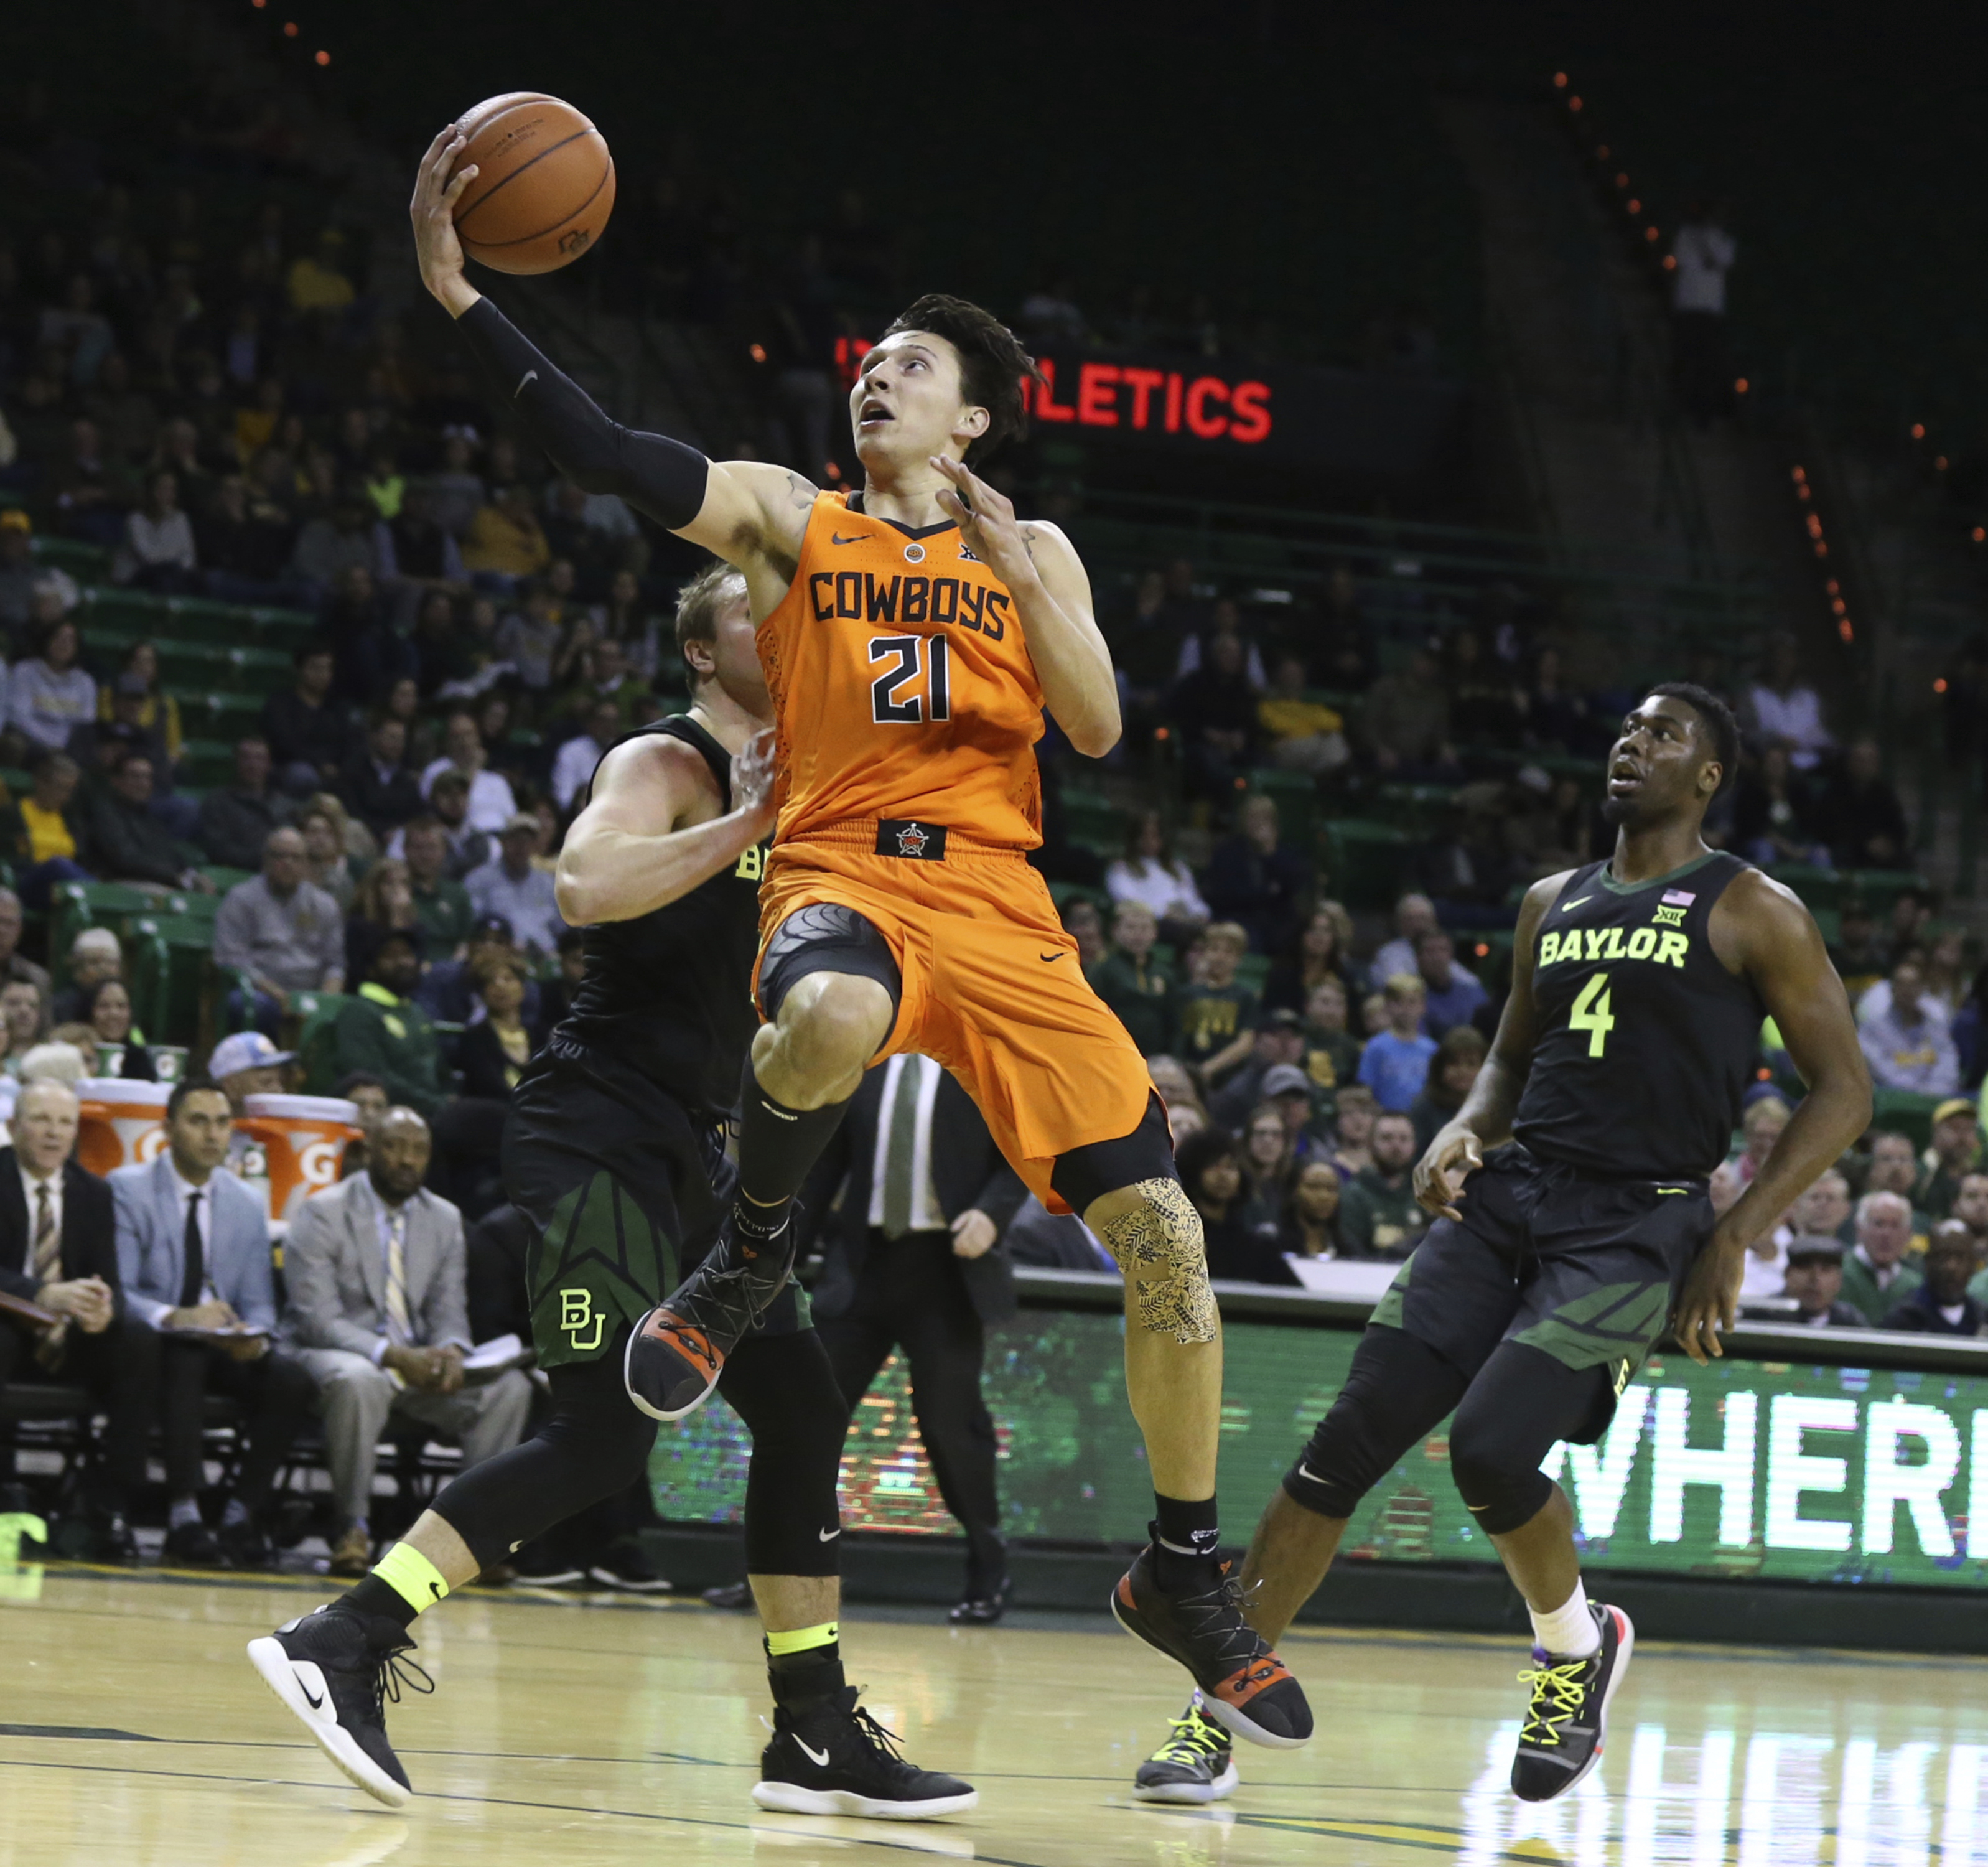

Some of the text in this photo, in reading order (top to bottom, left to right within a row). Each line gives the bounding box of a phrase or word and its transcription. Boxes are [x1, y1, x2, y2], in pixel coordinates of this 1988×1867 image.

[810, 571, 1010, 642] COWBOYS
[868, 633, 950, 724] 21
[735, 844, 771, 882] B
[1539, 927, 1689, 968] BAYLOR
[1568, 973, 1615, 1057] 4
[301, 1143, 336, 1182] G
[560, 1288, 606, 1350] BU
[1538, 1384, 1988, 1560] WHER
